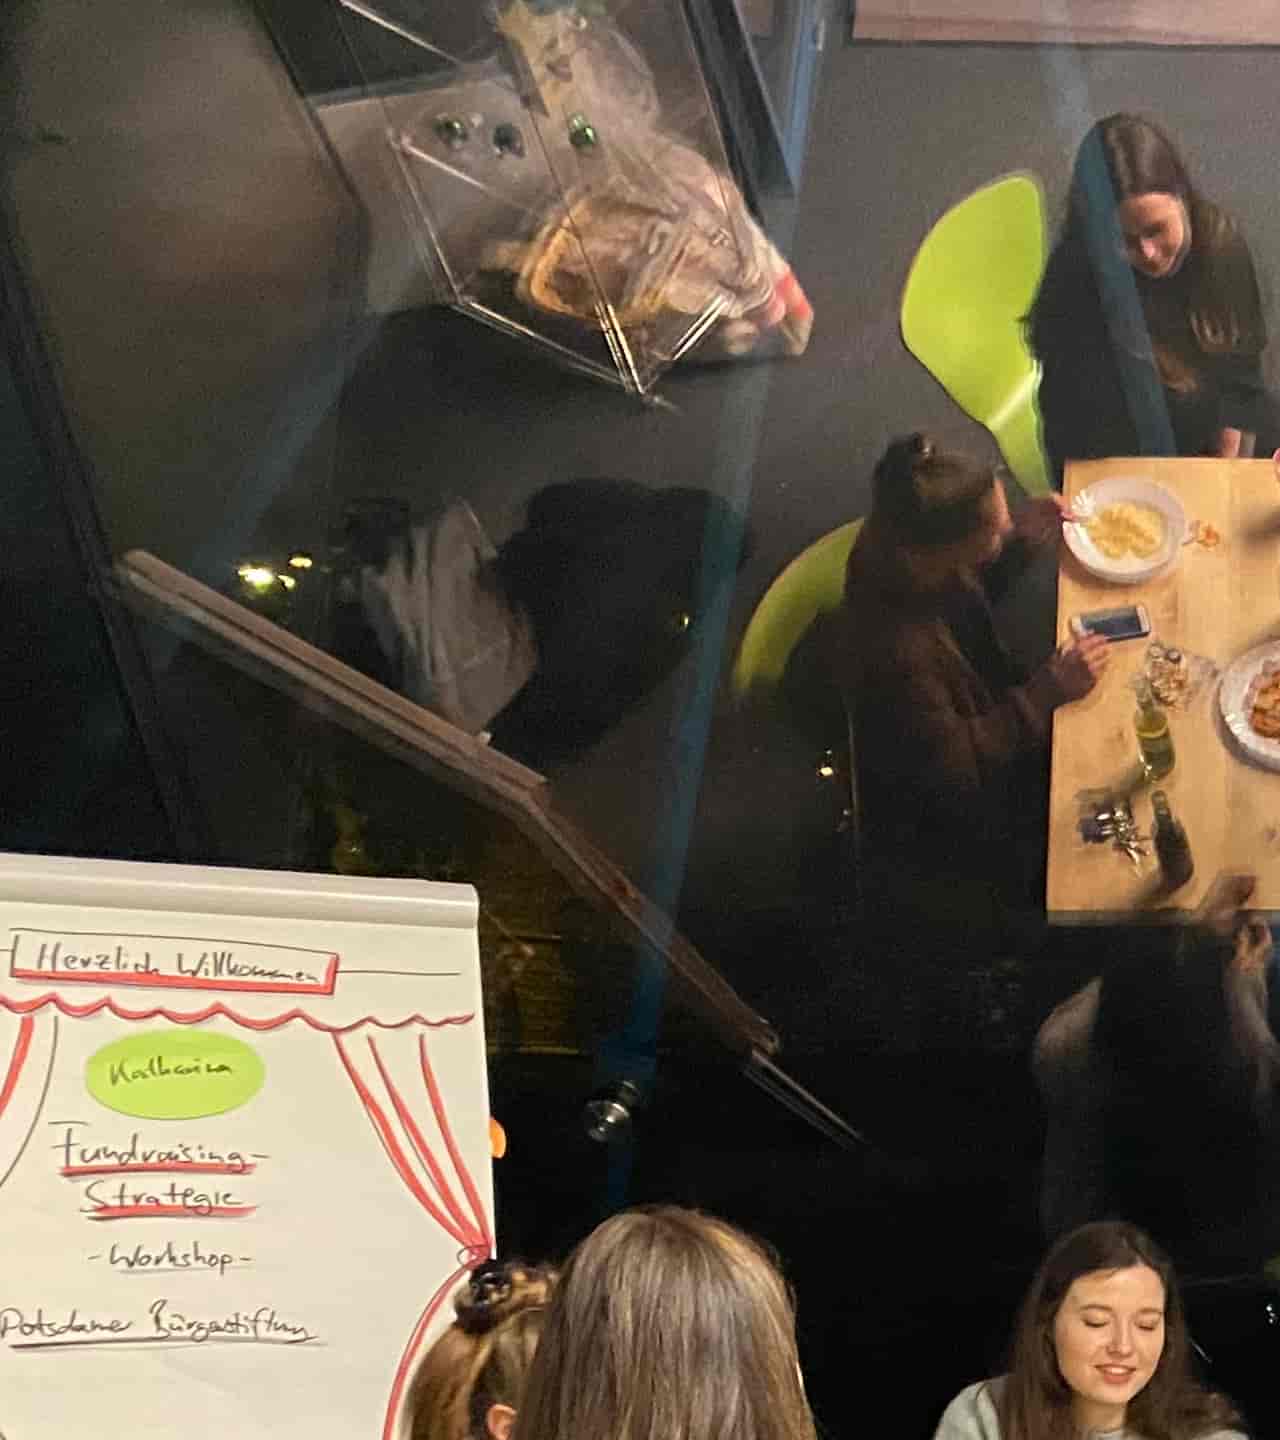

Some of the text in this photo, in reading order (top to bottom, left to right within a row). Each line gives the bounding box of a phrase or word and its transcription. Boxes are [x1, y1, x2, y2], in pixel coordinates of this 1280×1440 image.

[37, 941, 320, 983] Herzlich Willkommen
[109, 1055, 233, 1086] Katharina
[80, 1179, 243, 1216] Strategie
[0, 1307, 134, 1339] Potsdamer
